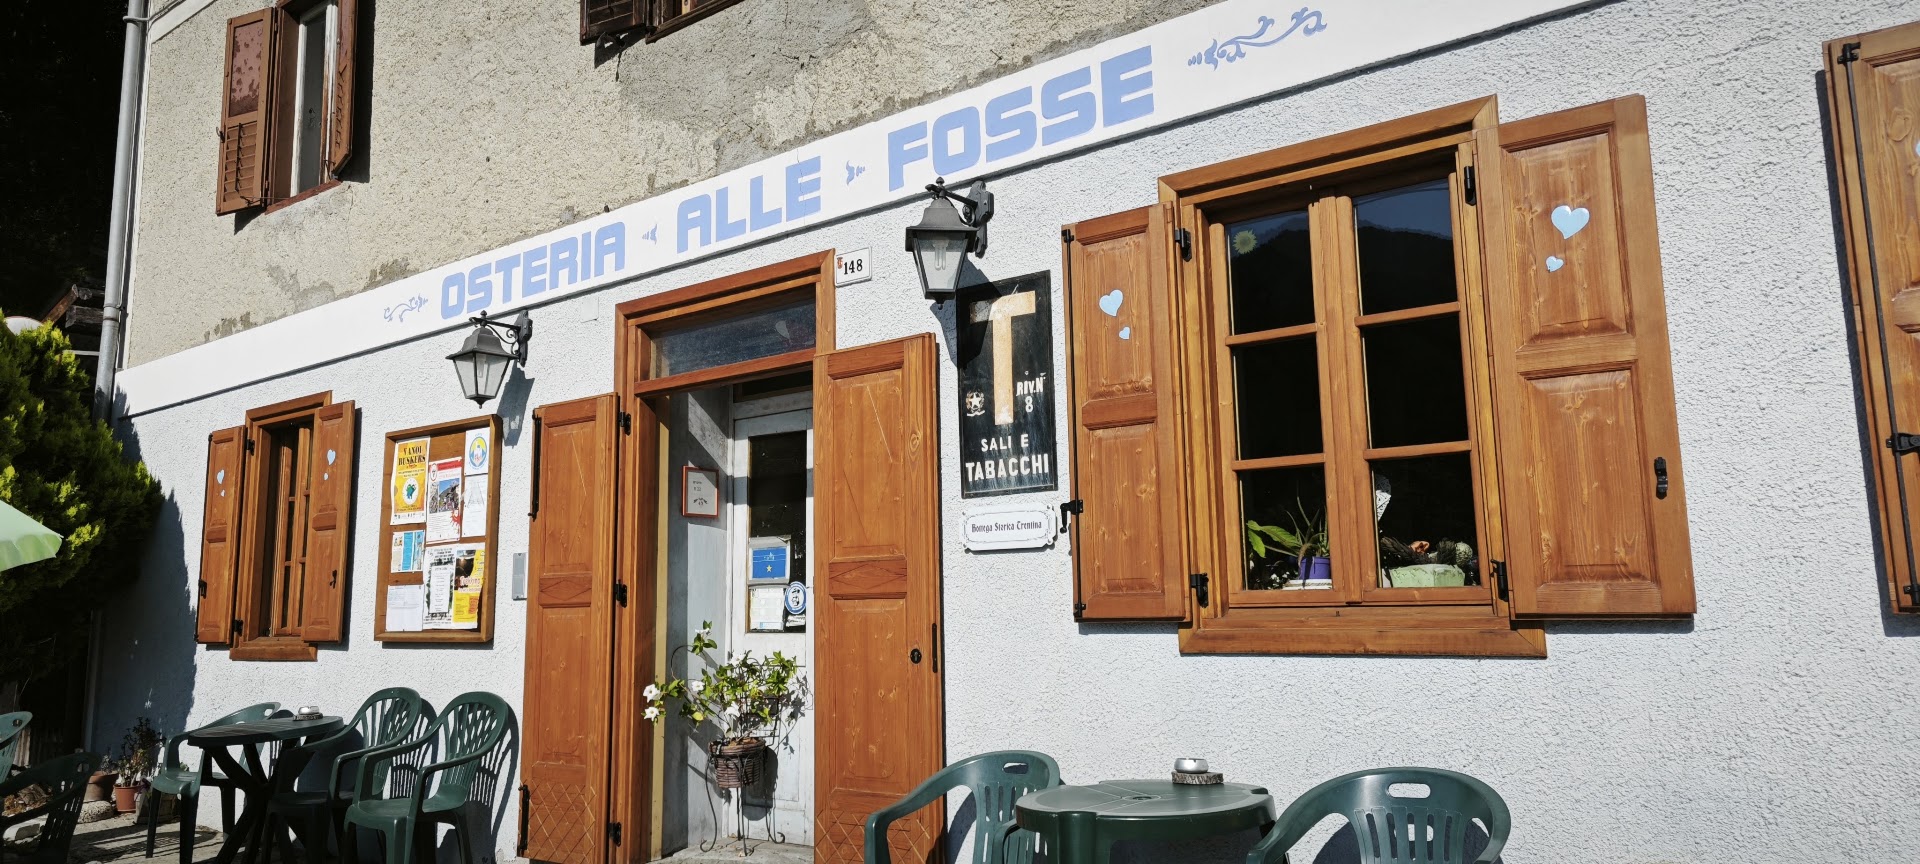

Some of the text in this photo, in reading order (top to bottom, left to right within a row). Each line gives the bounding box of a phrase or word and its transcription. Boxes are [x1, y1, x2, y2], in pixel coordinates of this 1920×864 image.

[442, 46, 1155, 319] OSTERIA ALLE FOSSE
[843, 258, 863, 275] 148
[969, 290, 1036, 426] T
[1025, 396, 1034, 413] 8
[981, 434, 1029, 452] SALI E
[398, 454, 426, 465] BUSKERS
[965, 453, 1049, 482] TABACCHI
[1016, 520, 1042, 530] Trentina
